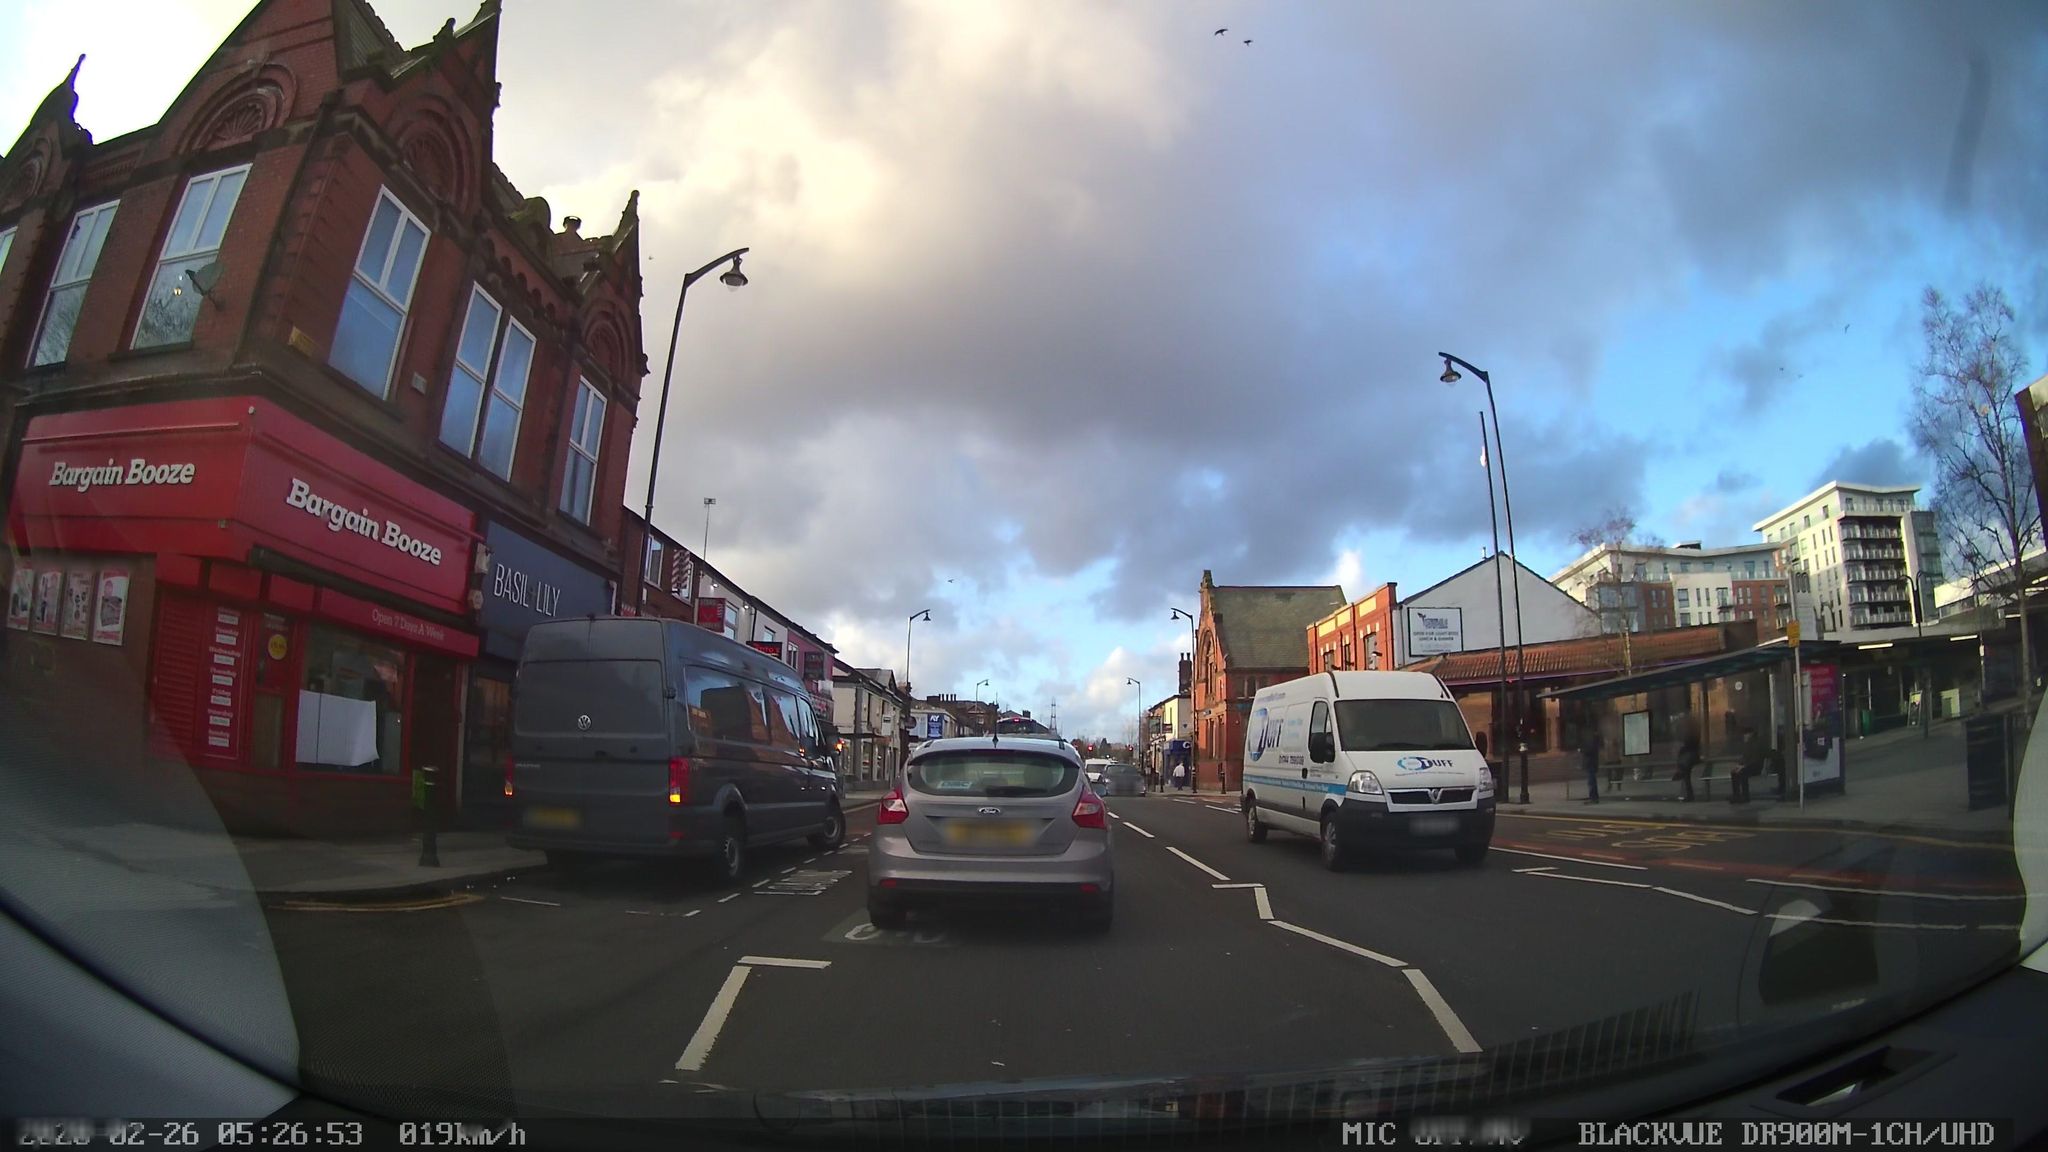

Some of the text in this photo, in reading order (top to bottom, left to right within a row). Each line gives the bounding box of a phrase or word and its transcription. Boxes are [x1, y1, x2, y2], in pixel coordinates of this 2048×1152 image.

[49, 458, 195, 492] Bargain Booze
[286, 477, 442, 566] Bargain Booze
[494, 563, 560, 617] BASIL LILY
[371, 608, 393, 626] Open
[1418, 757, 1454, 770] DUFF
